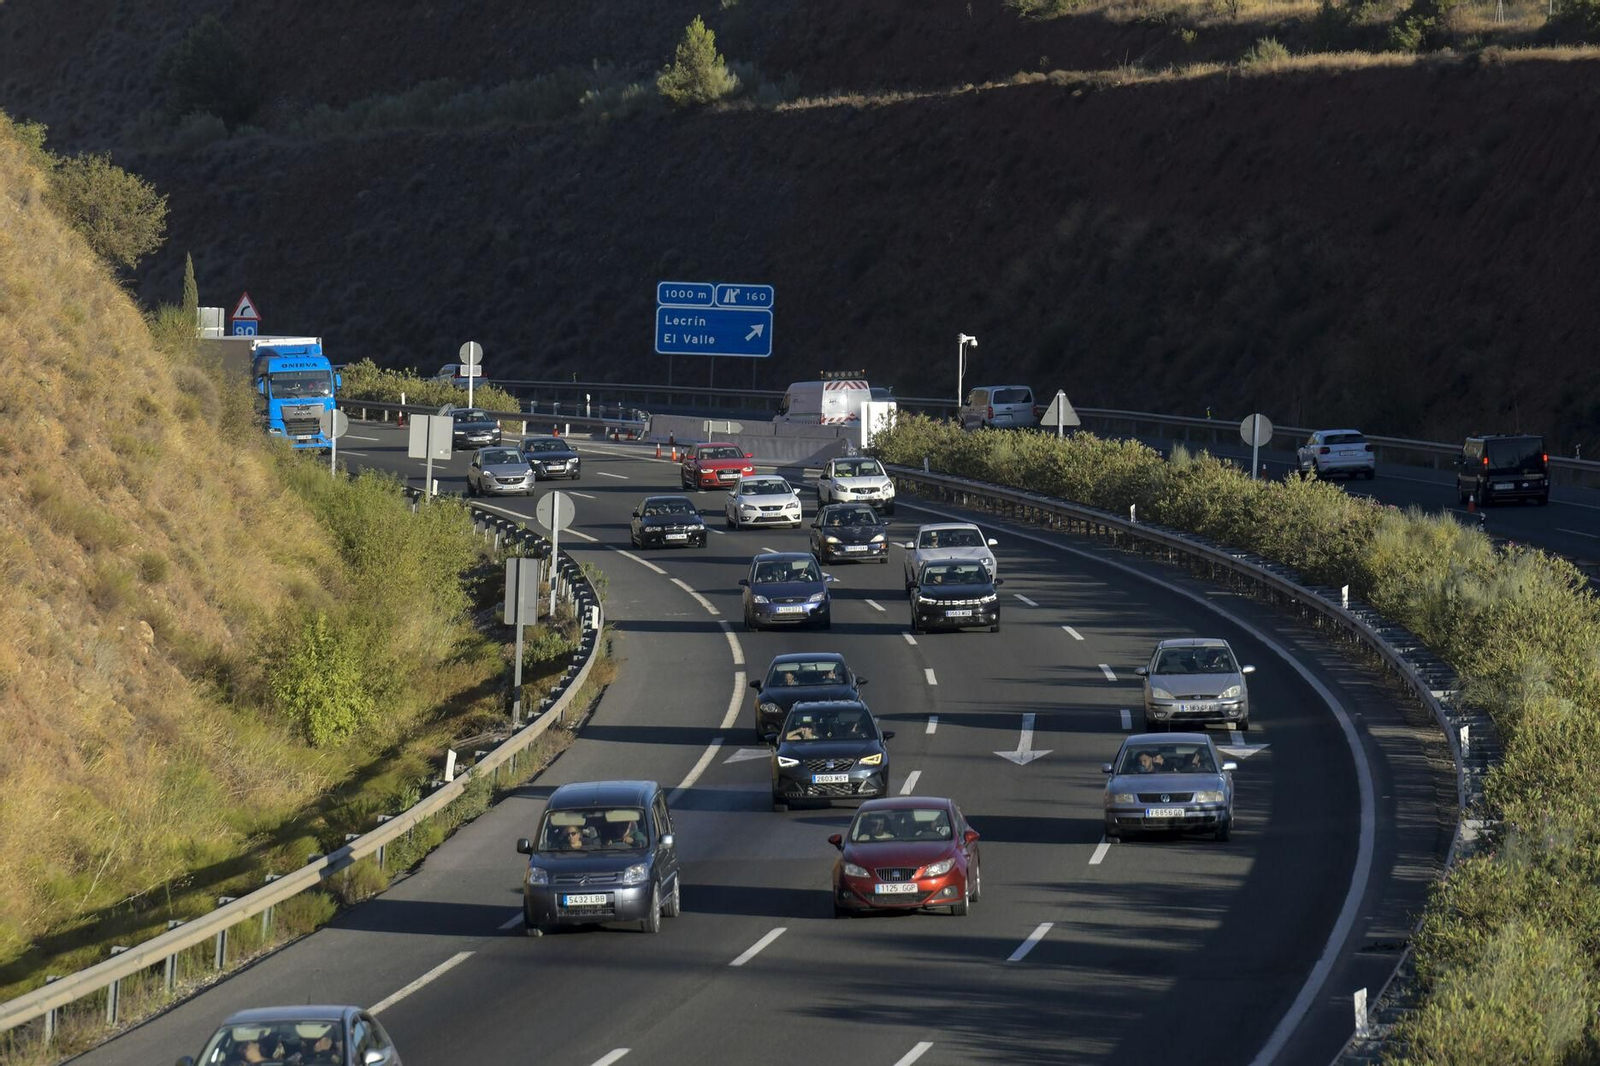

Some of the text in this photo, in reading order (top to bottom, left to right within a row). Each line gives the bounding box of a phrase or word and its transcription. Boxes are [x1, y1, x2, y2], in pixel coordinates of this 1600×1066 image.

[665, 290, 694, 299] 1000
[746, 292, 766, 301] 160
[665, 315, 706, 326] Lecrín
[235, 326, 255, 336] 90
[664, 333, 715, 344] El Valle
[816, 774, 847, 783] 2603 MSY
[881, 884, 916, 892] 1125 GGP
[568, 895, 588, 904] 5432
